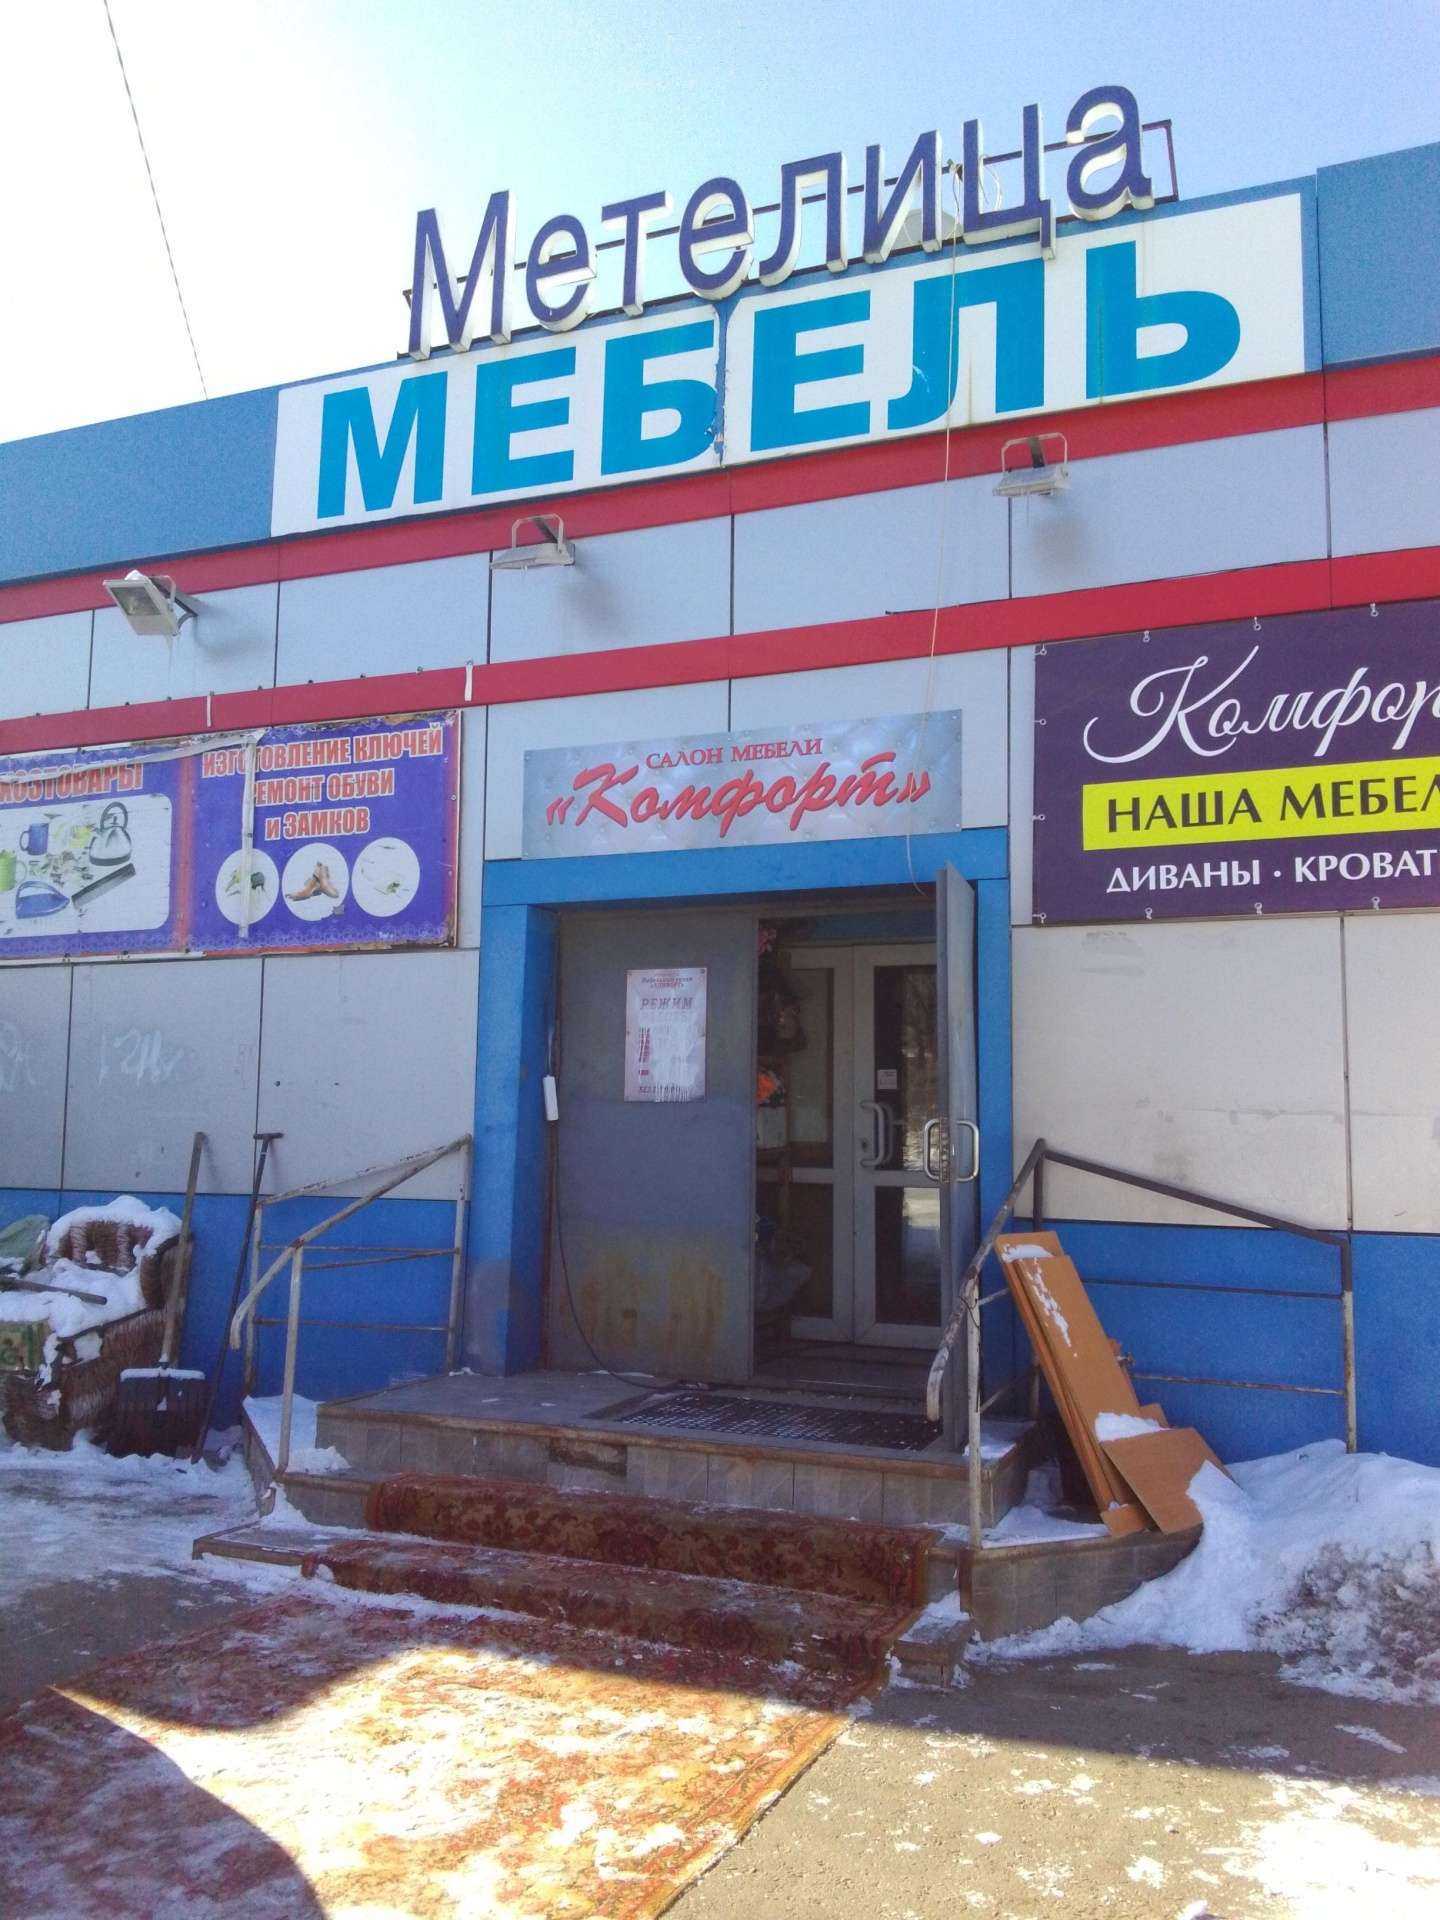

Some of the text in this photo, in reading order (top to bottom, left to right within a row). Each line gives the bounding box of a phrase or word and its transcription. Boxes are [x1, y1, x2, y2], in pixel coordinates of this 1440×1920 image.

[408, 85, 1154, 360] Метелица
[316, 240, 1241, 518] МЕБЕЛЬ
[353, 722, 443, 763] КЛЮЧЕЙ
[645, 738, 823, 769] САЛОН МЕБЕЛИ
[253, 768, 395, 807] ЕМОНТ ОБУВИ
[546, 751, 931, 838] «Комфорт»
[283, 807, 370, 839] ЗАМКОВ
[1108, 788, 1262, 832] НАША
[1106, 859, 1260, 893] ДИВАНЫ
